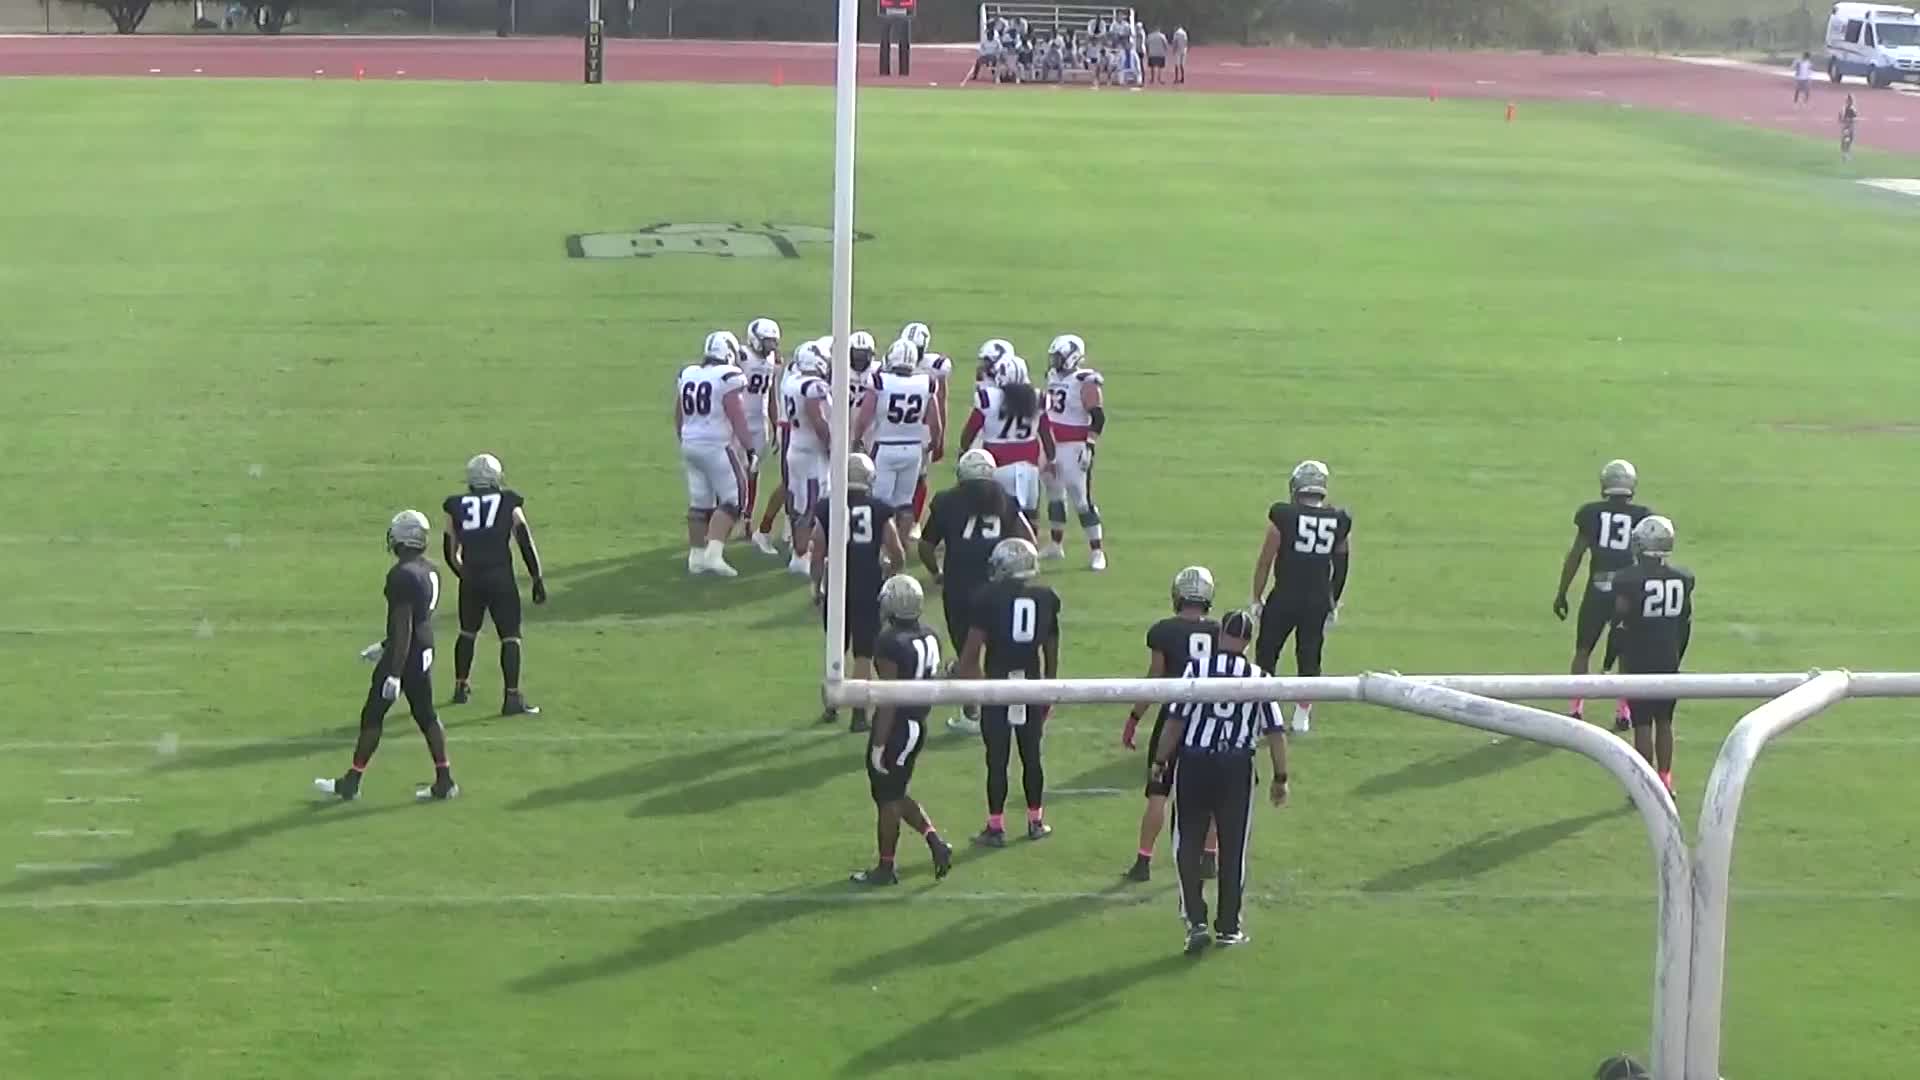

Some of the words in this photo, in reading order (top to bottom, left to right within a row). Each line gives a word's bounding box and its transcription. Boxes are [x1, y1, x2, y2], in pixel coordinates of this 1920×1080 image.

[682, 381, 713, 416] 68
[886, 393, 923, 424] 52
[461, 493, 501, 530] 37
[1599, 511, 1632, 550] 13
[1295, 514, 1338, 555] 55
[428, 571, 440, 611] 1
[1643, 579, 1684, 618] 20
[1012, 597, 1037, 643] 0
